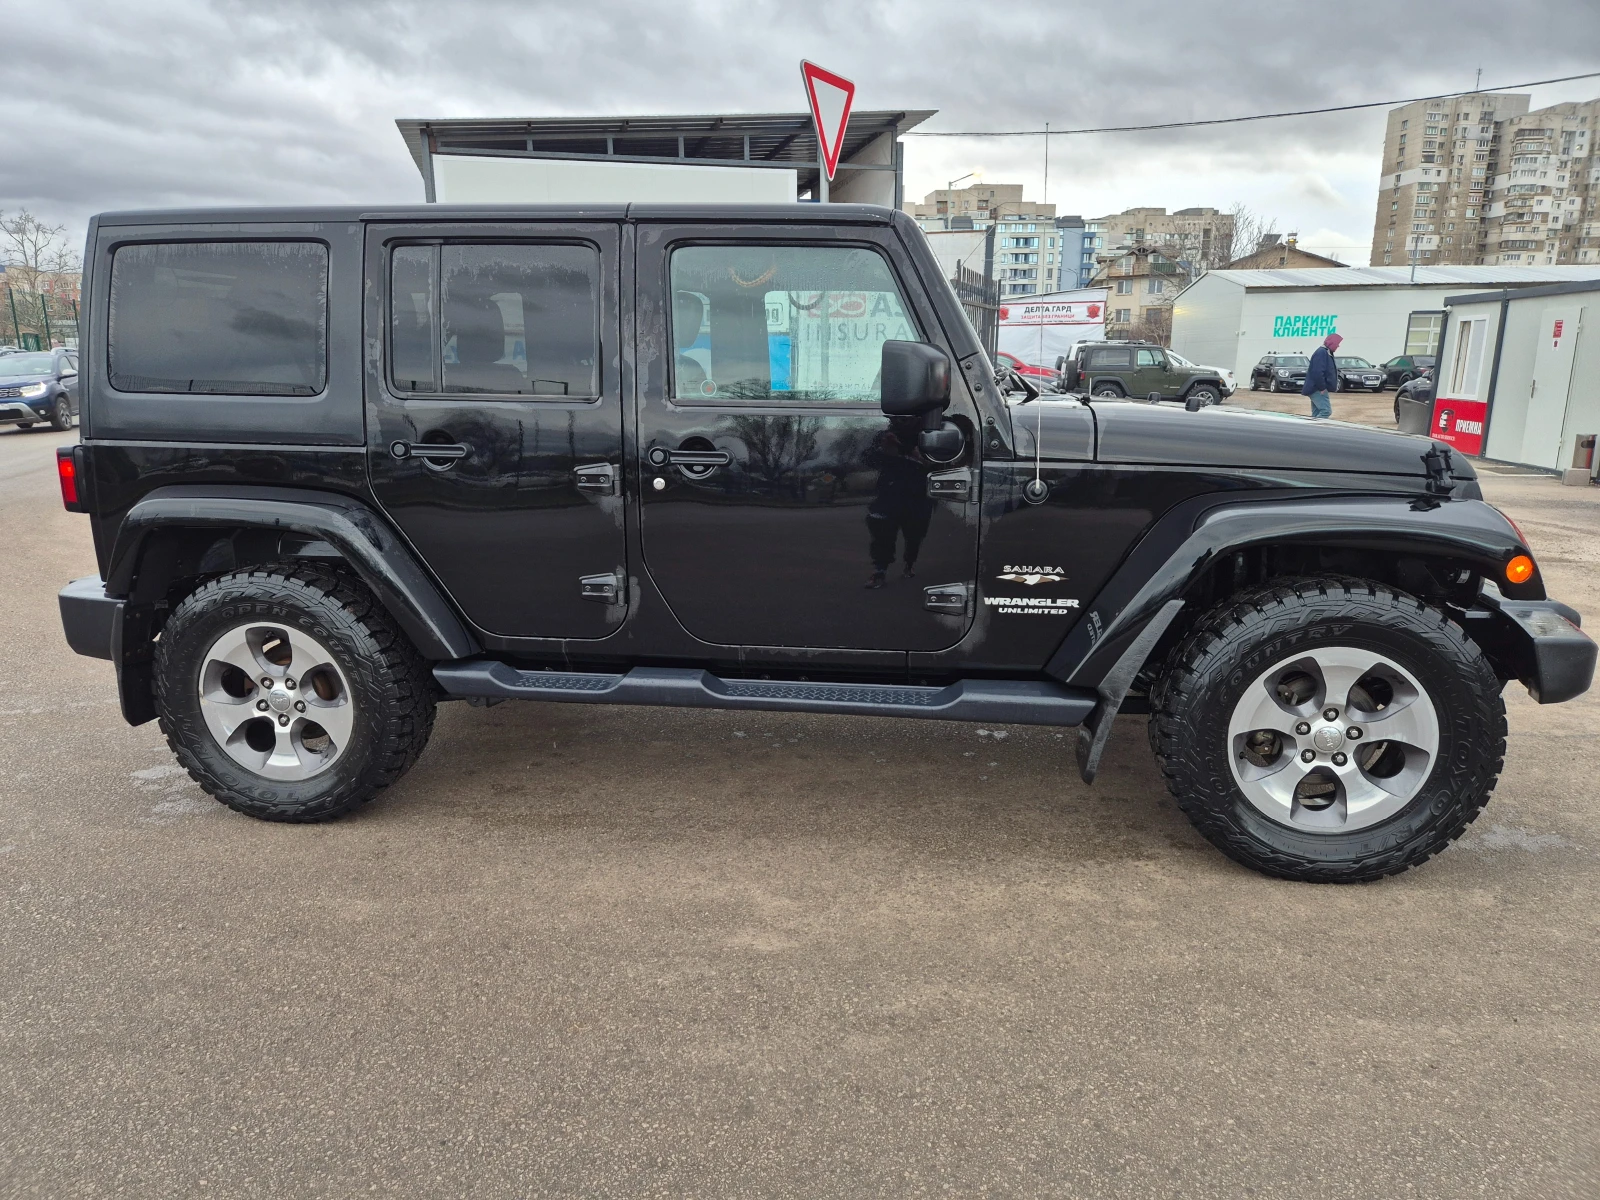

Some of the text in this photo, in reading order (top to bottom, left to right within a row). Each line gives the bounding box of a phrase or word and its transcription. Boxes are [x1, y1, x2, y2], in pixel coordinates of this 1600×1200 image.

[1024, 305, 1072, 314] ДЕЛТА ГАРД
[1275, 314, 1338, 327] ПАРКИНГ
[1273, 326, 1336, 338] КЛИЕНТИ
[1455, 419, 1483, 436] ПРИЕМНА
[1003, 565, 1065, 574] SAHARA
[983, 597, 1080, 608] WRANGLER
[221, 602, 289, 622] OPEN
[998, 607, 1068, 615] UNLIMITED
[1219, 623, 1354, 704] COUNTRY
[216, 771, 300, 803] TOYO
